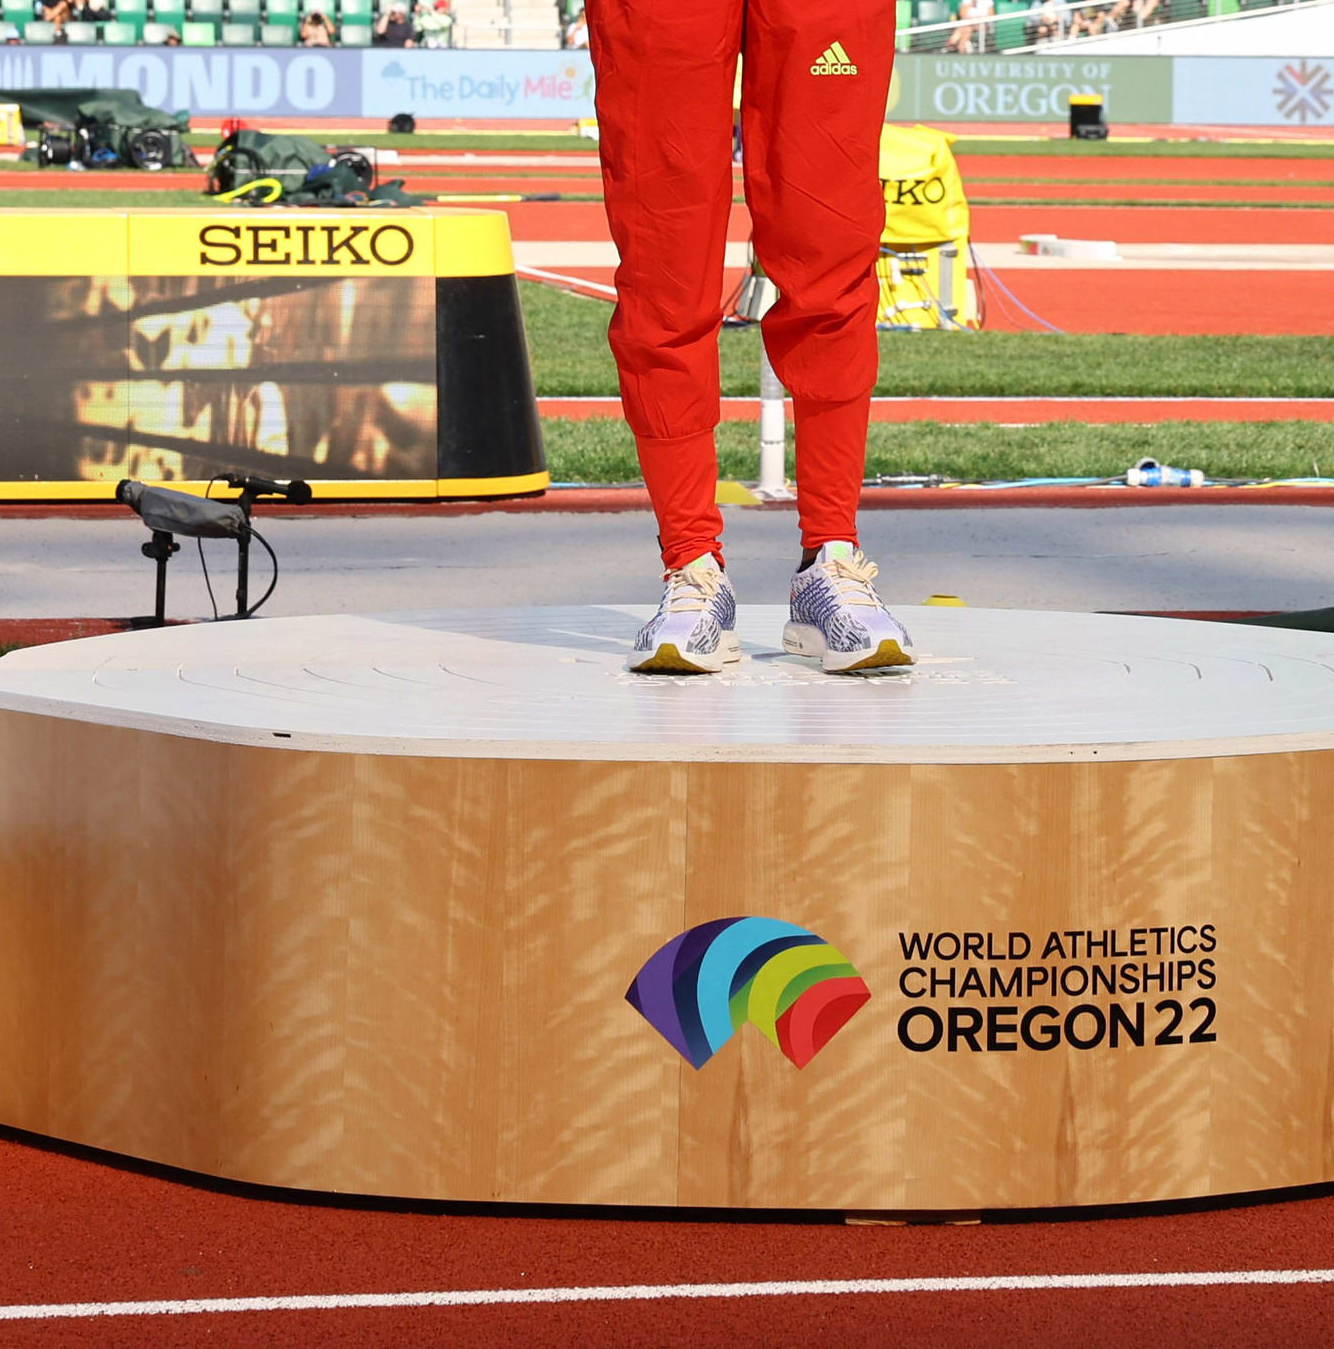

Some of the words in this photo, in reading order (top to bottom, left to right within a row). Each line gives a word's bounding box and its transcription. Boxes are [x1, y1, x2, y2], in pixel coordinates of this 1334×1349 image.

[41, 54, 335, 111] MONDO
[810, 62, 858, 76] adidas
[934, 61, 1076, 79] UNIVERSITY
[1082, 62, 1113, 80] OF
[405, 75, 454, 100] The
[458, 75, 520, 106] Daily
[524, 75, 573, 100] Mile
[880, 177, 946, 204] IKO
[199, 225, 414, 266] SEIKO
[898, 932, 1031, 961] WORLD
[1041, 924, 1217, 960] ATHLETICS
[899, 958, 1216, 998] CHAMPIONSHIPS
[897, 997, 1217, 1053] OREGON22
